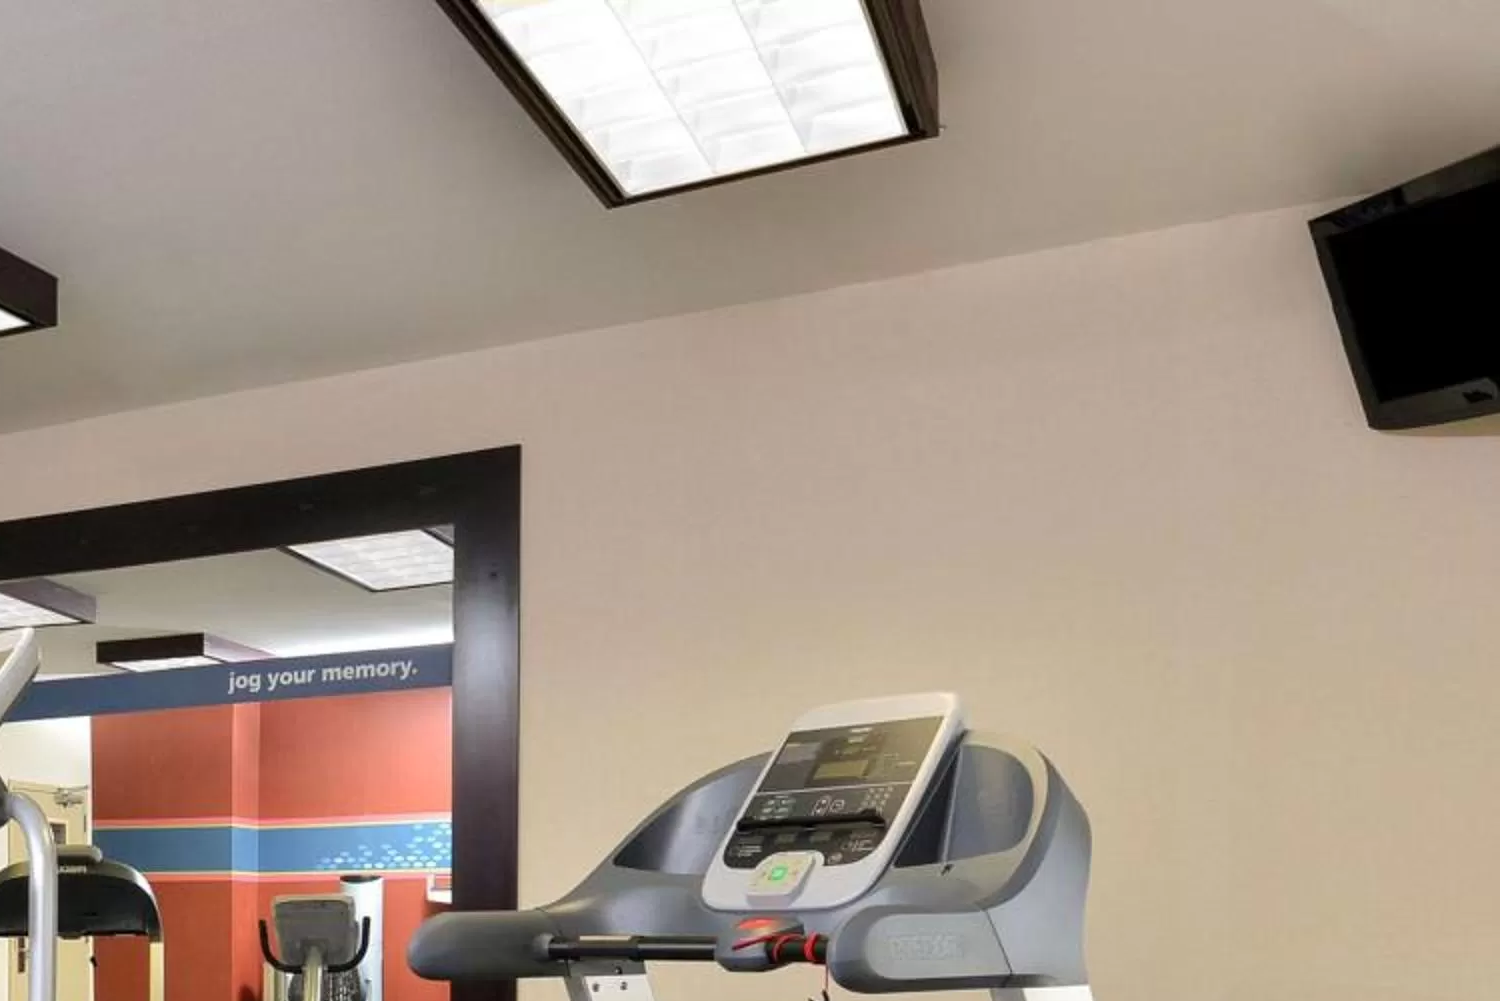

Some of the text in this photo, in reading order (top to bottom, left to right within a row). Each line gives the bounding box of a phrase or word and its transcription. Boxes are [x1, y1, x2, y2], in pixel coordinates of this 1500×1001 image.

[227, 659, 418, 695] jog your memory.
